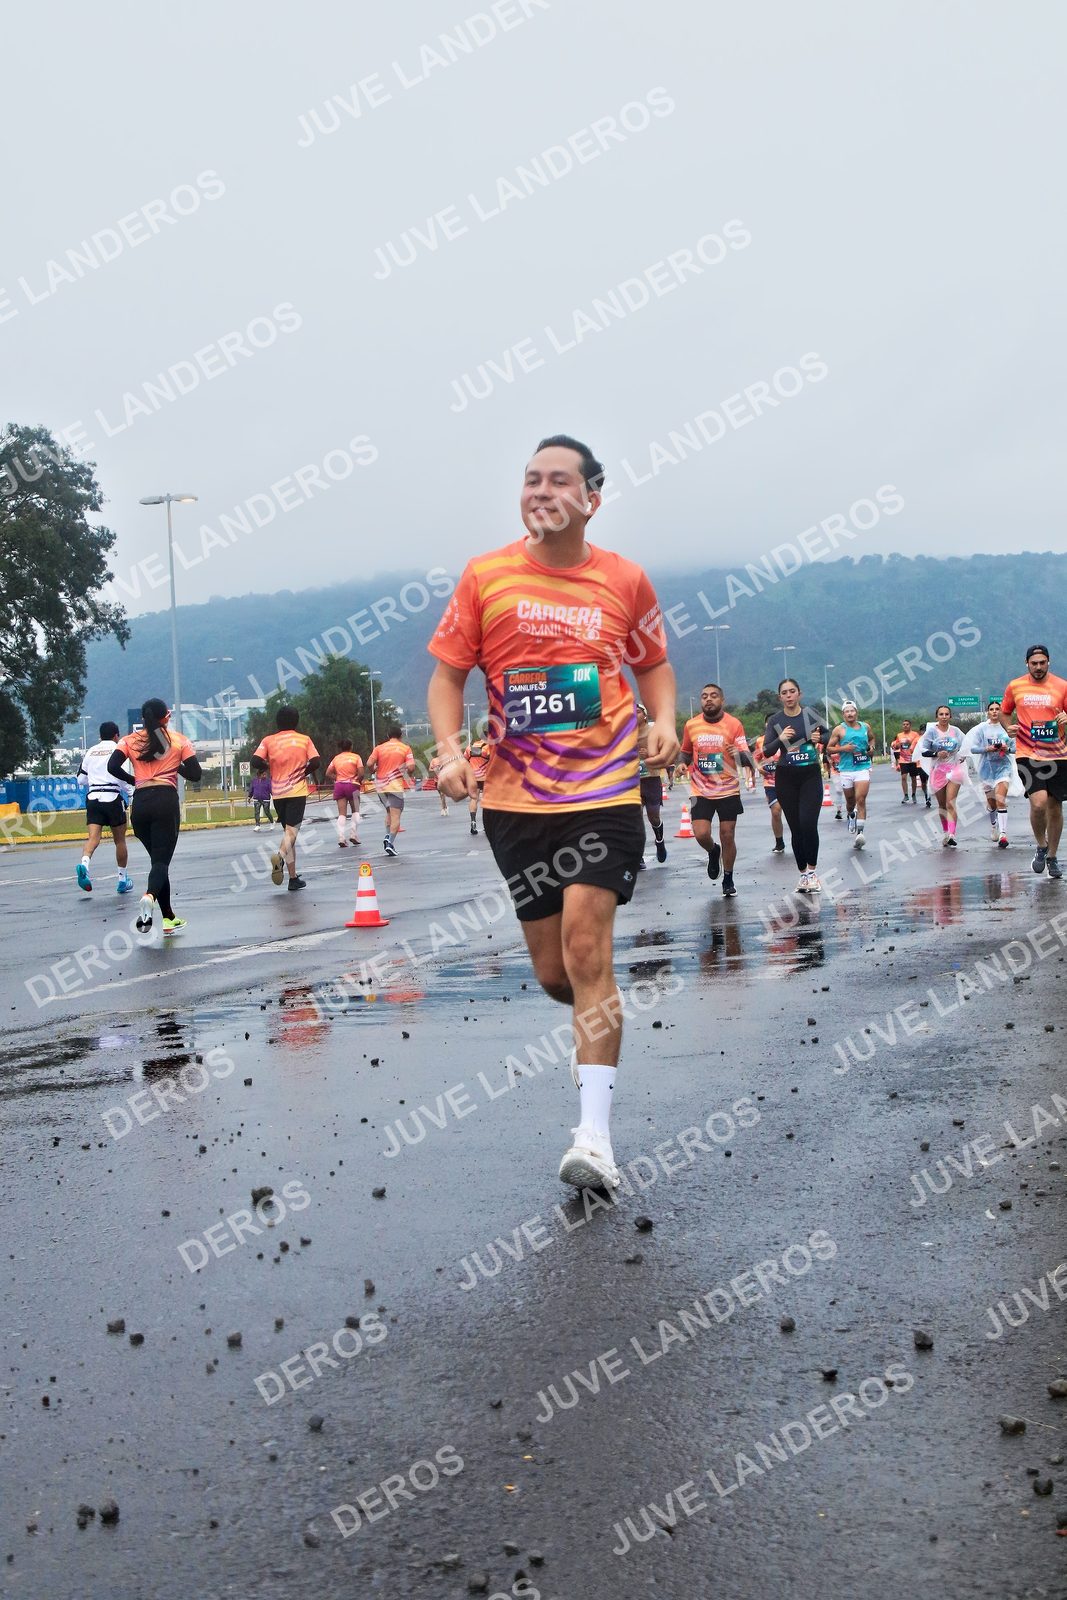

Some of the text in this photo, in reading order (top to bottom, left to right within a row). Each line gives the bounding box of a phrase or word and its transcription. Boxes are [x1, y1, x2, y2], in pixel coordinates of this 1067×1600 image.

[517, 599, 602, 627] CARRERA
[509, 672, 547, 684] CARRERA
[573, 668, 591, 682] 10K
[509, 683, 538, 692] OMNILIFE
[520, 692, 576, 715] 1261
[791, 753, 809, 762] 1622
